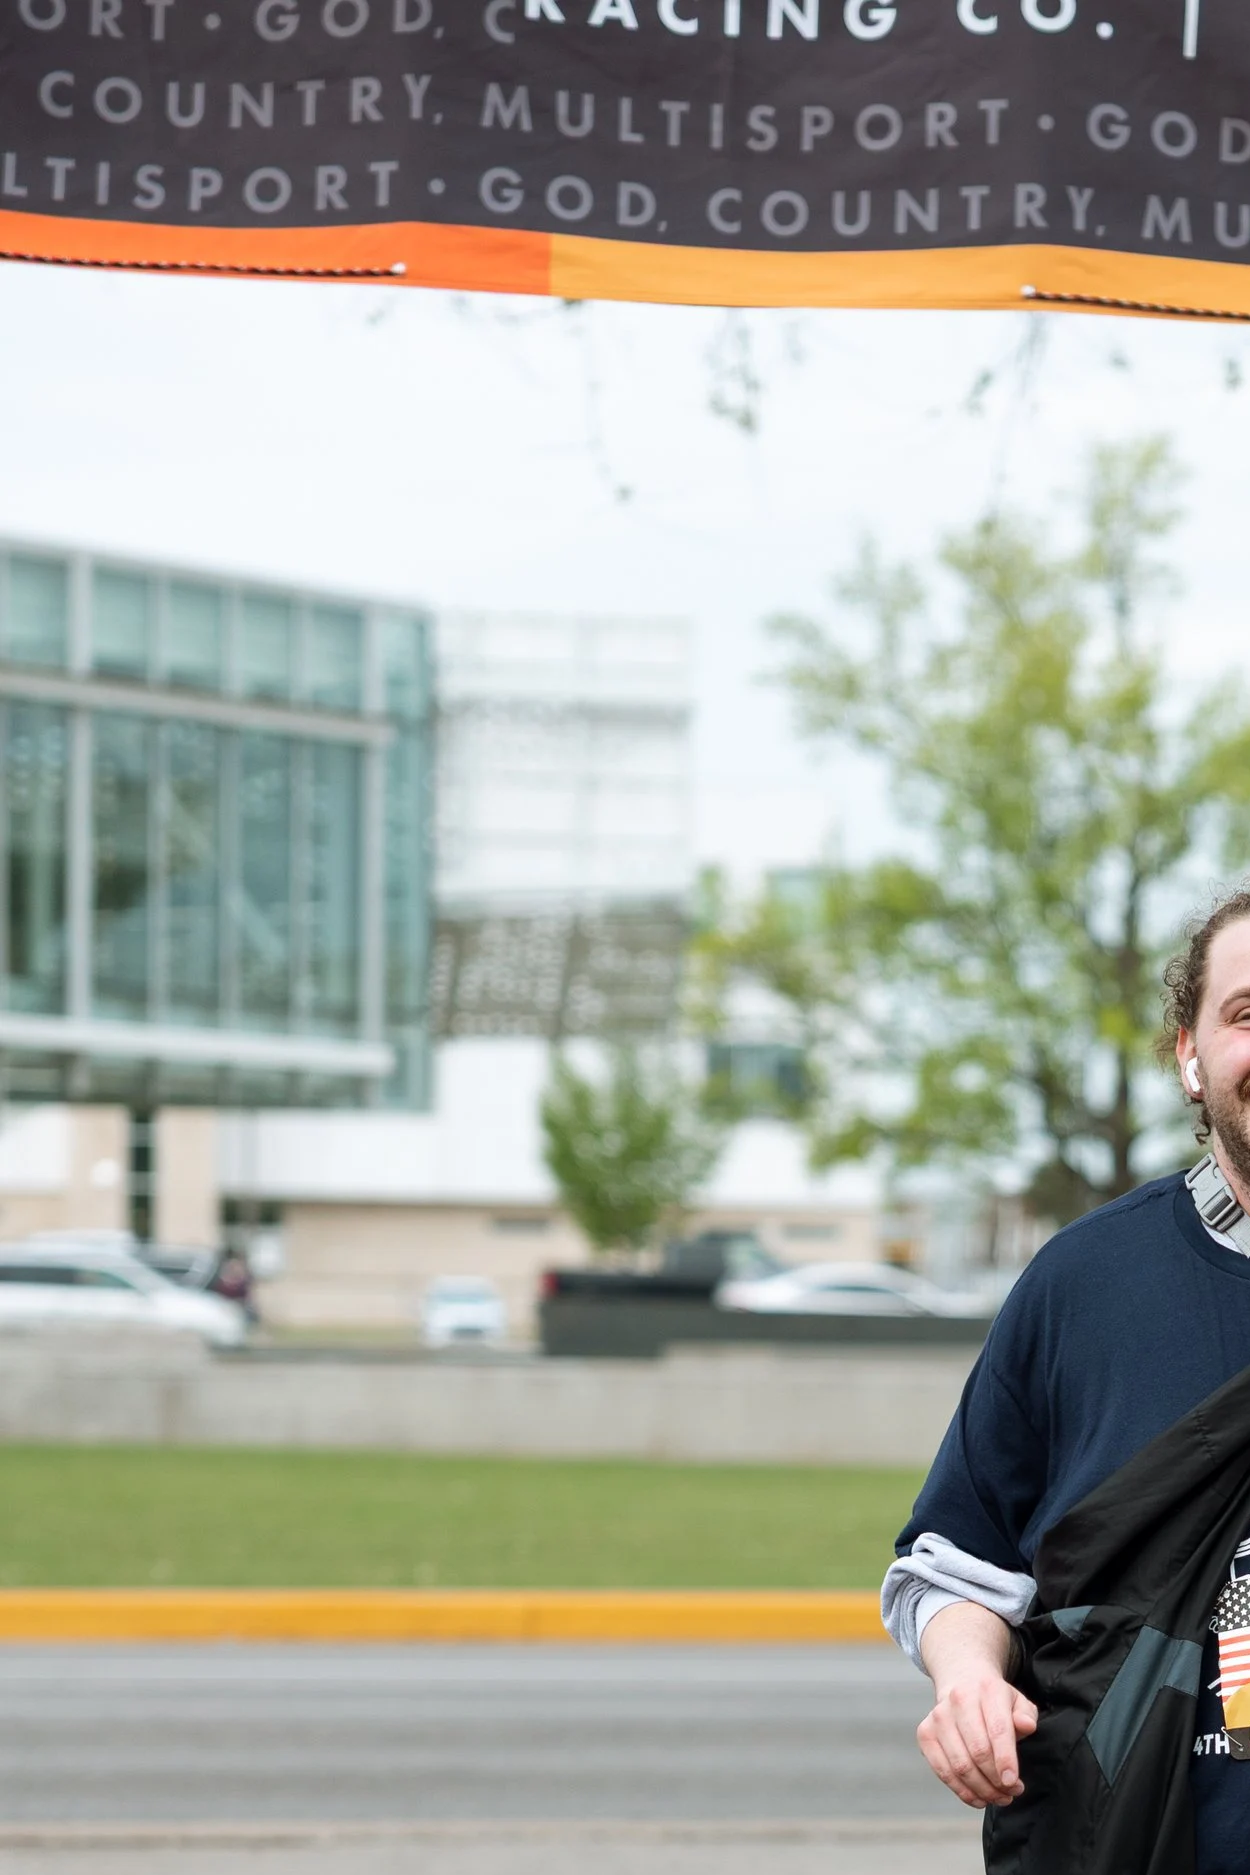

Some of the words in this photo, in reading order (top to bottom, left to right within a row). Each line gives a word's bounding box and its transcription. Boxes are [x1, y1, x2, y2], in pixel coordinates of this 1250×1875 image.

[956, 0, 1114, 41] CO.
[39, 70, 443, 129] COUNTRY,
[481, 83, 1010, 152] MULTISPORT
[479, 166, 668, 233] GOD,
[706, 182, 1105, 236] COUNTRY,
[1192, 1733, 1231, 1756] 4TH
